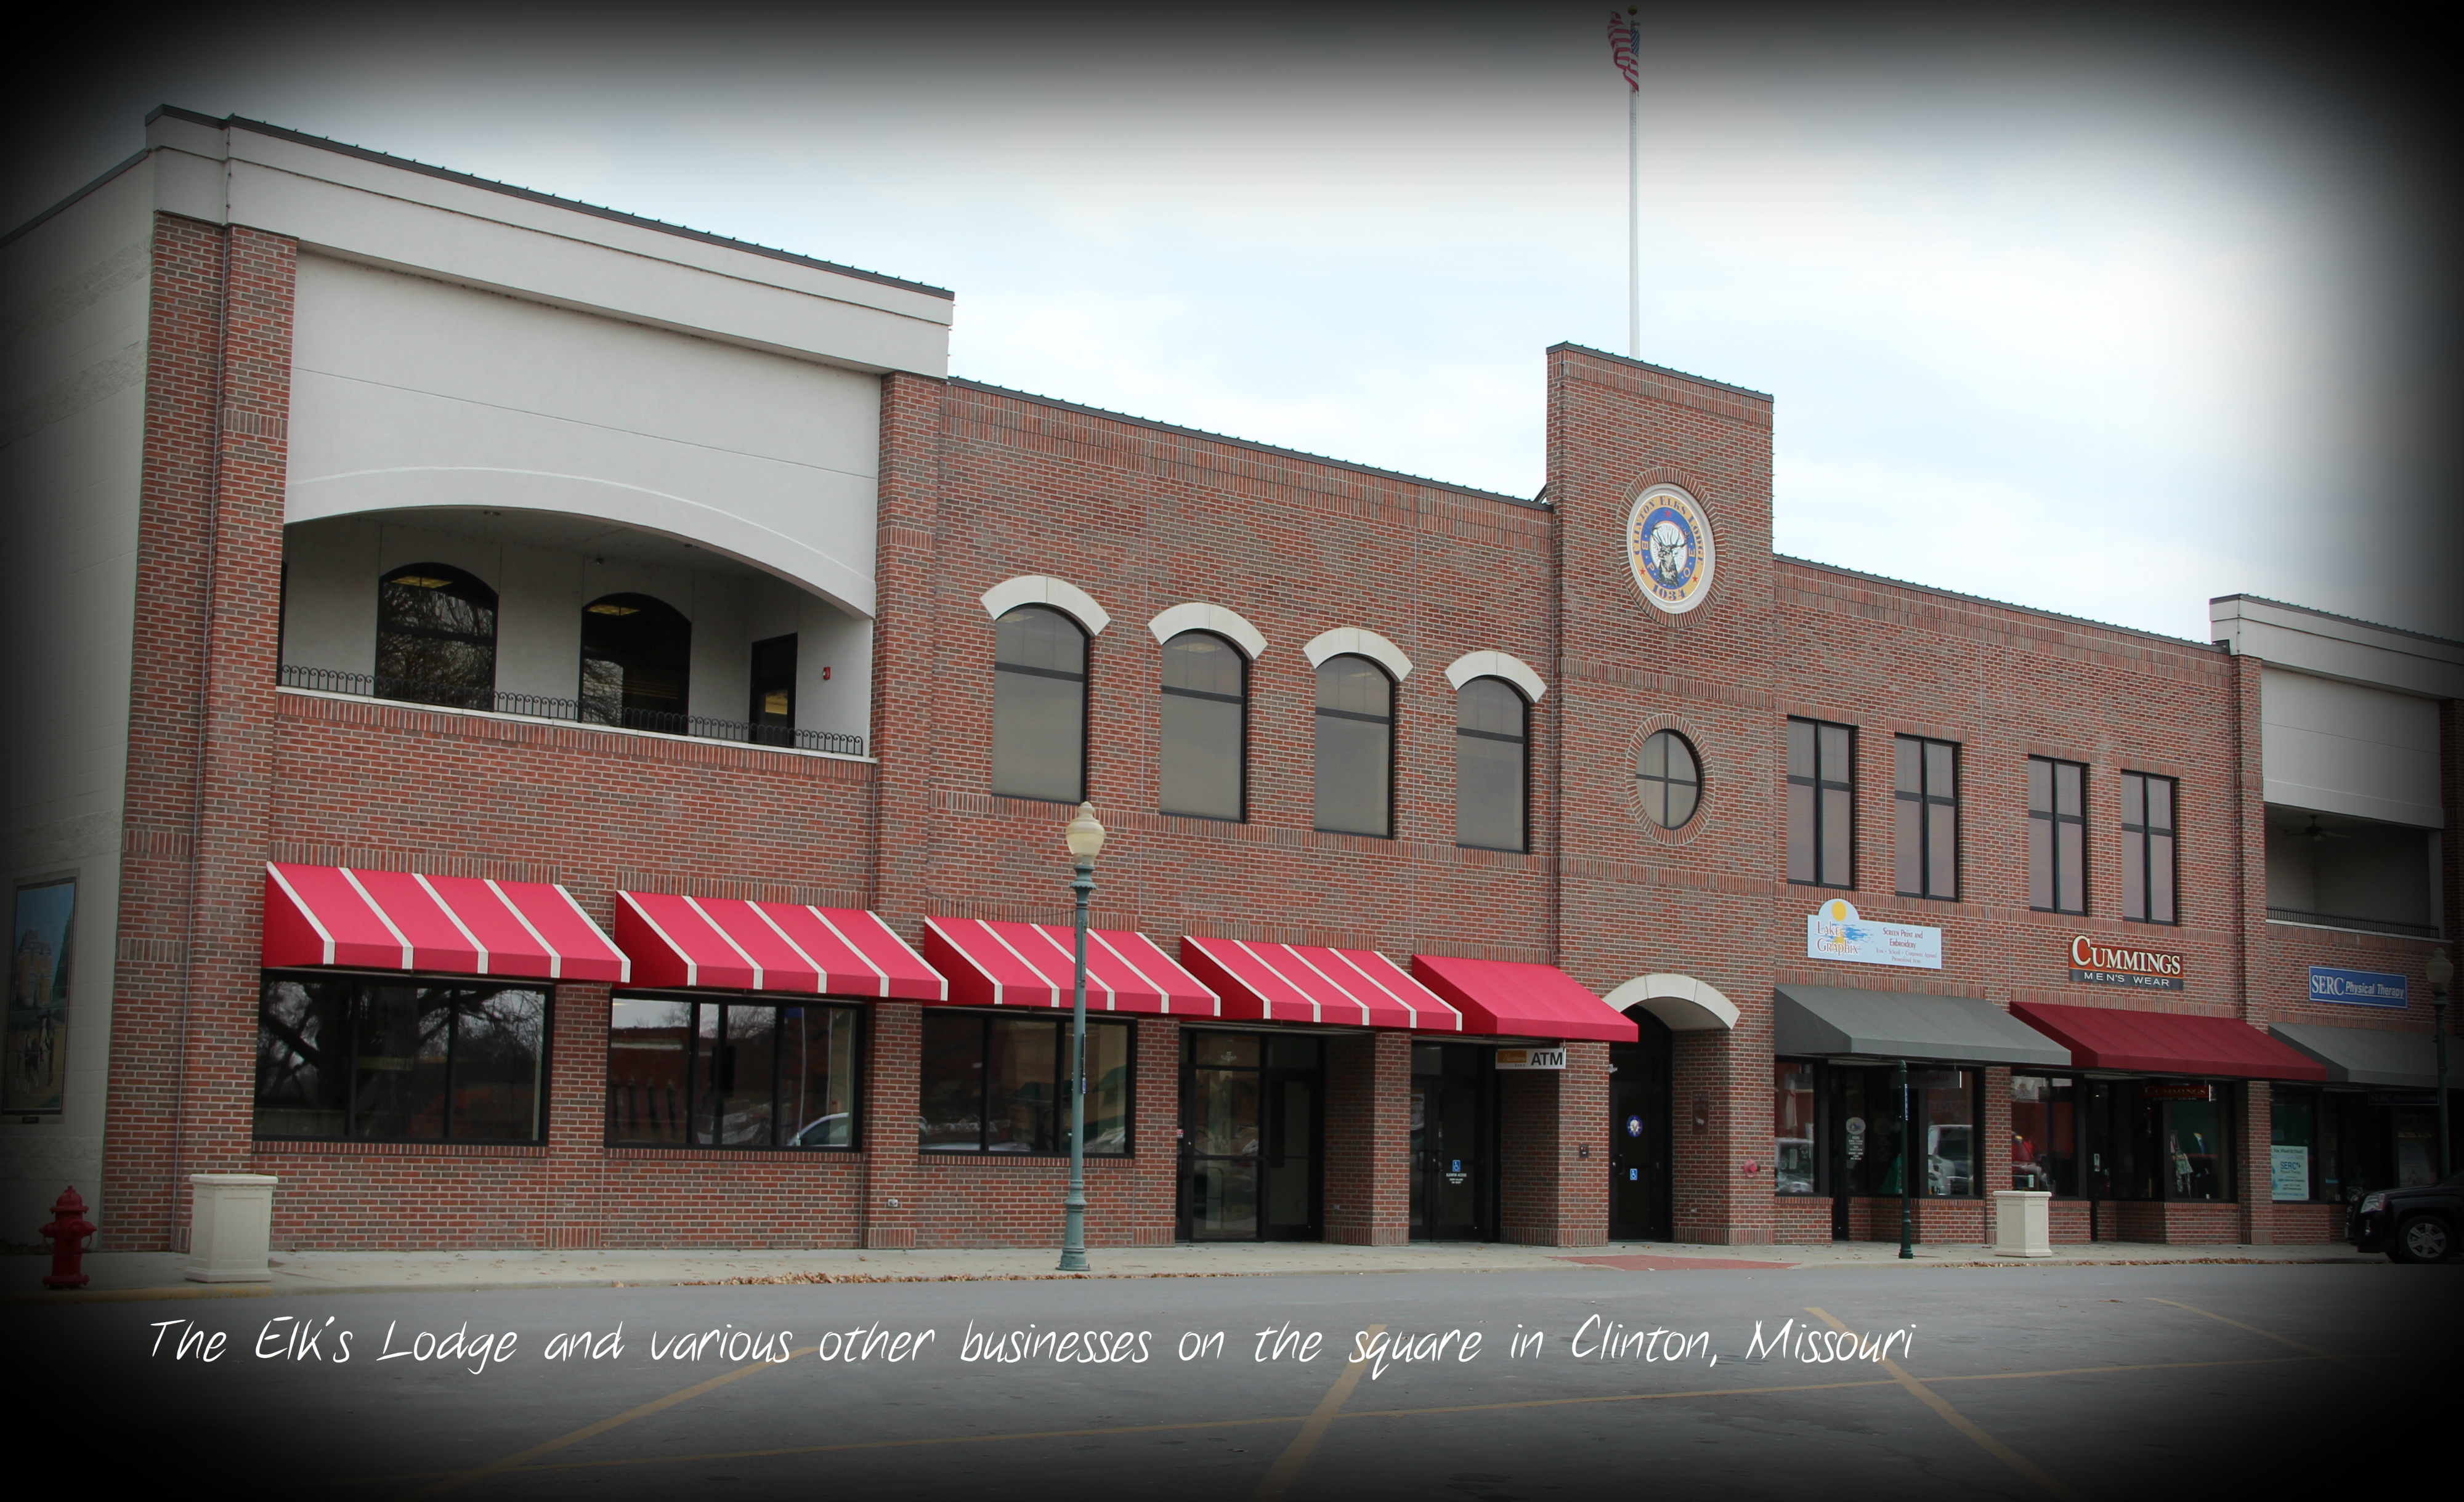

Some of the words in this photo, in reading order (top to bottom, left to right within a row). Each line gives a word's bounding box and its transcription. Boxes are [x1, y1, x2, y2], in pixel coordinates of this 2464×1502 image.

[1633, 499, 1655, 555] CLINTON
[1660, 496, 1687, 515] ELKS
[1688, 515, 1704, 565] LODGE
[1652, 584, 1687, 602] 1034
[1817, 920, 1841, 936] Lake
[2072, 935, 2181, 975] CUMMINGS
[2084, 972, 2125, 982] MEN'S
[2133, 976, 2170, 987] WEAR
[2311, 974, 2344, 996] SERC
[2345, 980, 2374, 995] Physical
[2377, 983, 2404, 998] Therapy
[1531, 1052, 1562, 1065] ATM
[2280, 1161, 2296, 1169] SERC
